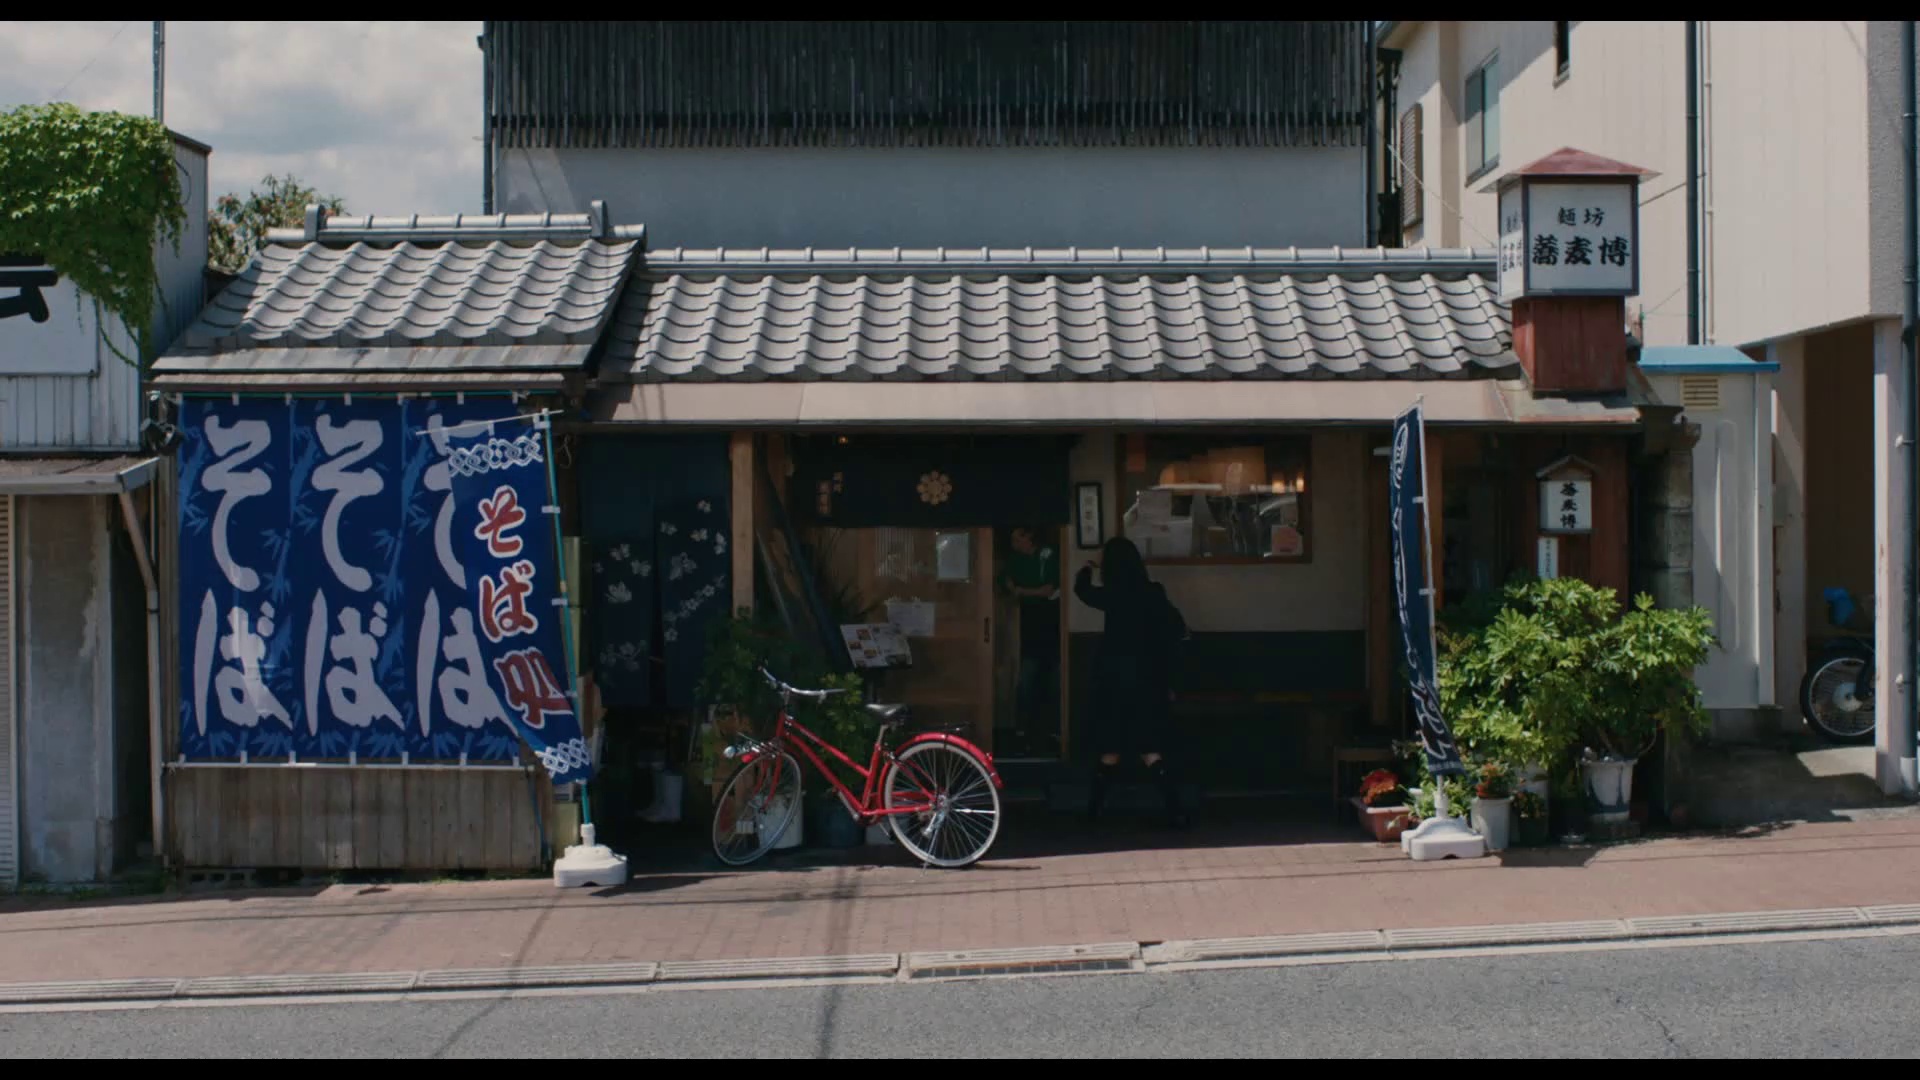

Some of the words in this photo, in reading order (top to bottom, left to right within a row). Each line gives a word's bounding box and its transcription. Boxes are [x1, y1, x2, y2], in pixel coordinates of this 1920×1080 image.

[1532, 234, 1630, 268] 蕎麦博
[193, 413, 295, 737] そば
[304, 413, 407, 737] そば
[474, 484, 575, 730] そば処
